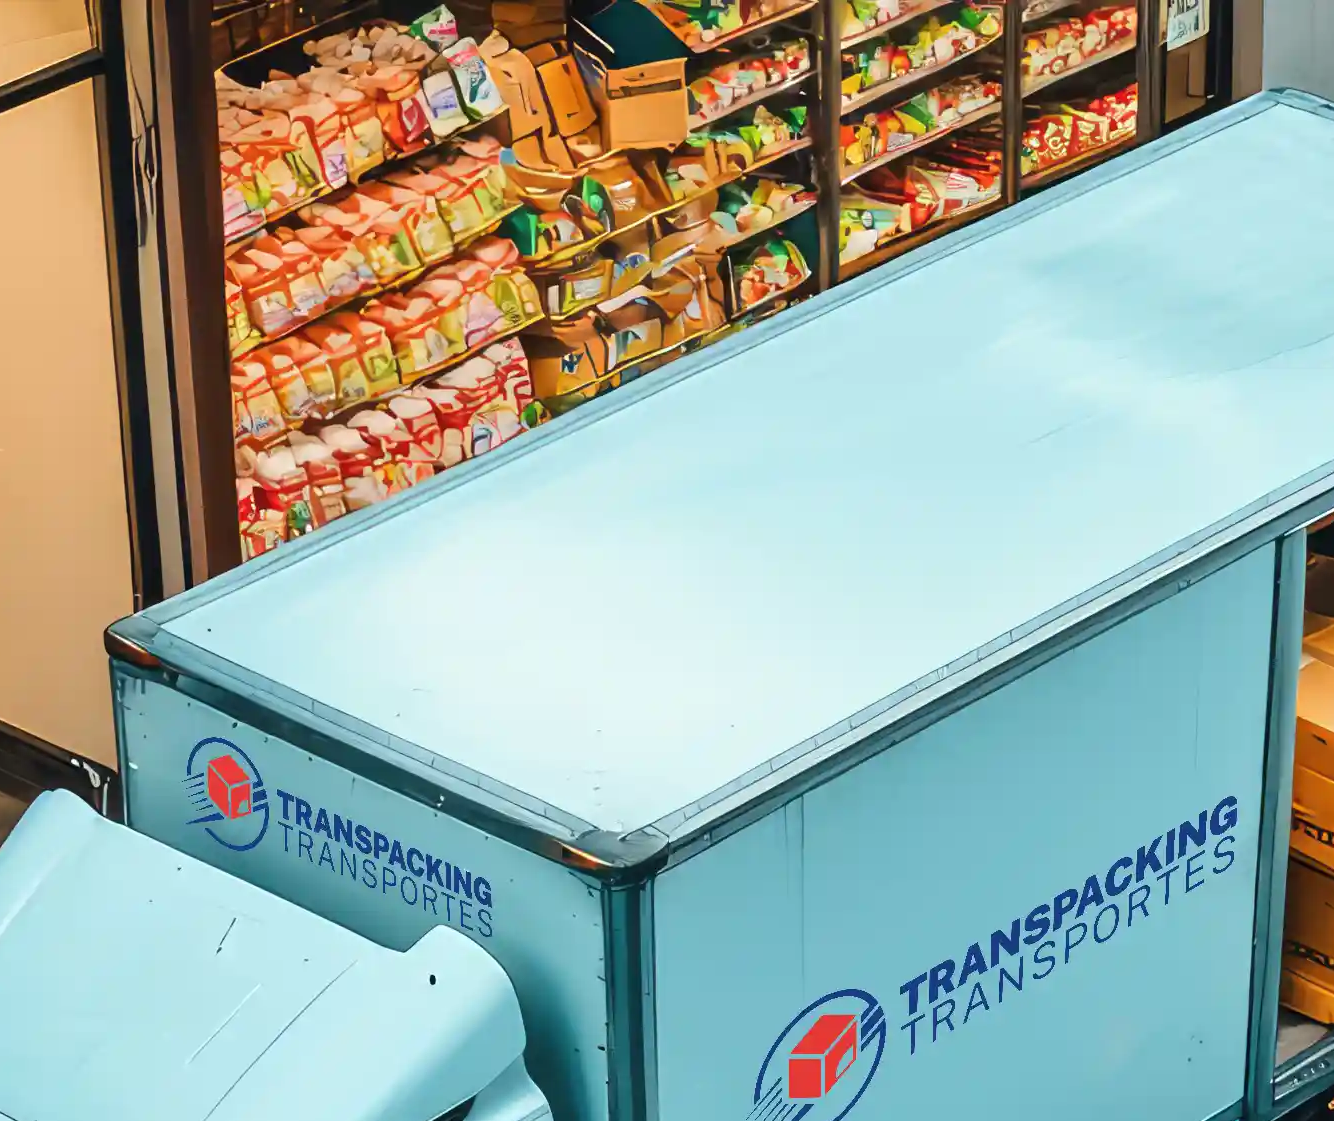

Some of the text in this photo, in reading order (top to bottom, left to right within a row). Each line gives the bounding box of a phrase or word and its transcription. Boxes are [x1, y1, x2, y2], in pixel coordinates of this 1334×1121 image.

[276, 788, 494, 909] TRANSPACKING
[277, 820, 494, 938] TRANSPORTES
[899, 795, 1239, 1017] TRANSPACKING
[900, 834, 1237, 1056] TRANSPORTES
